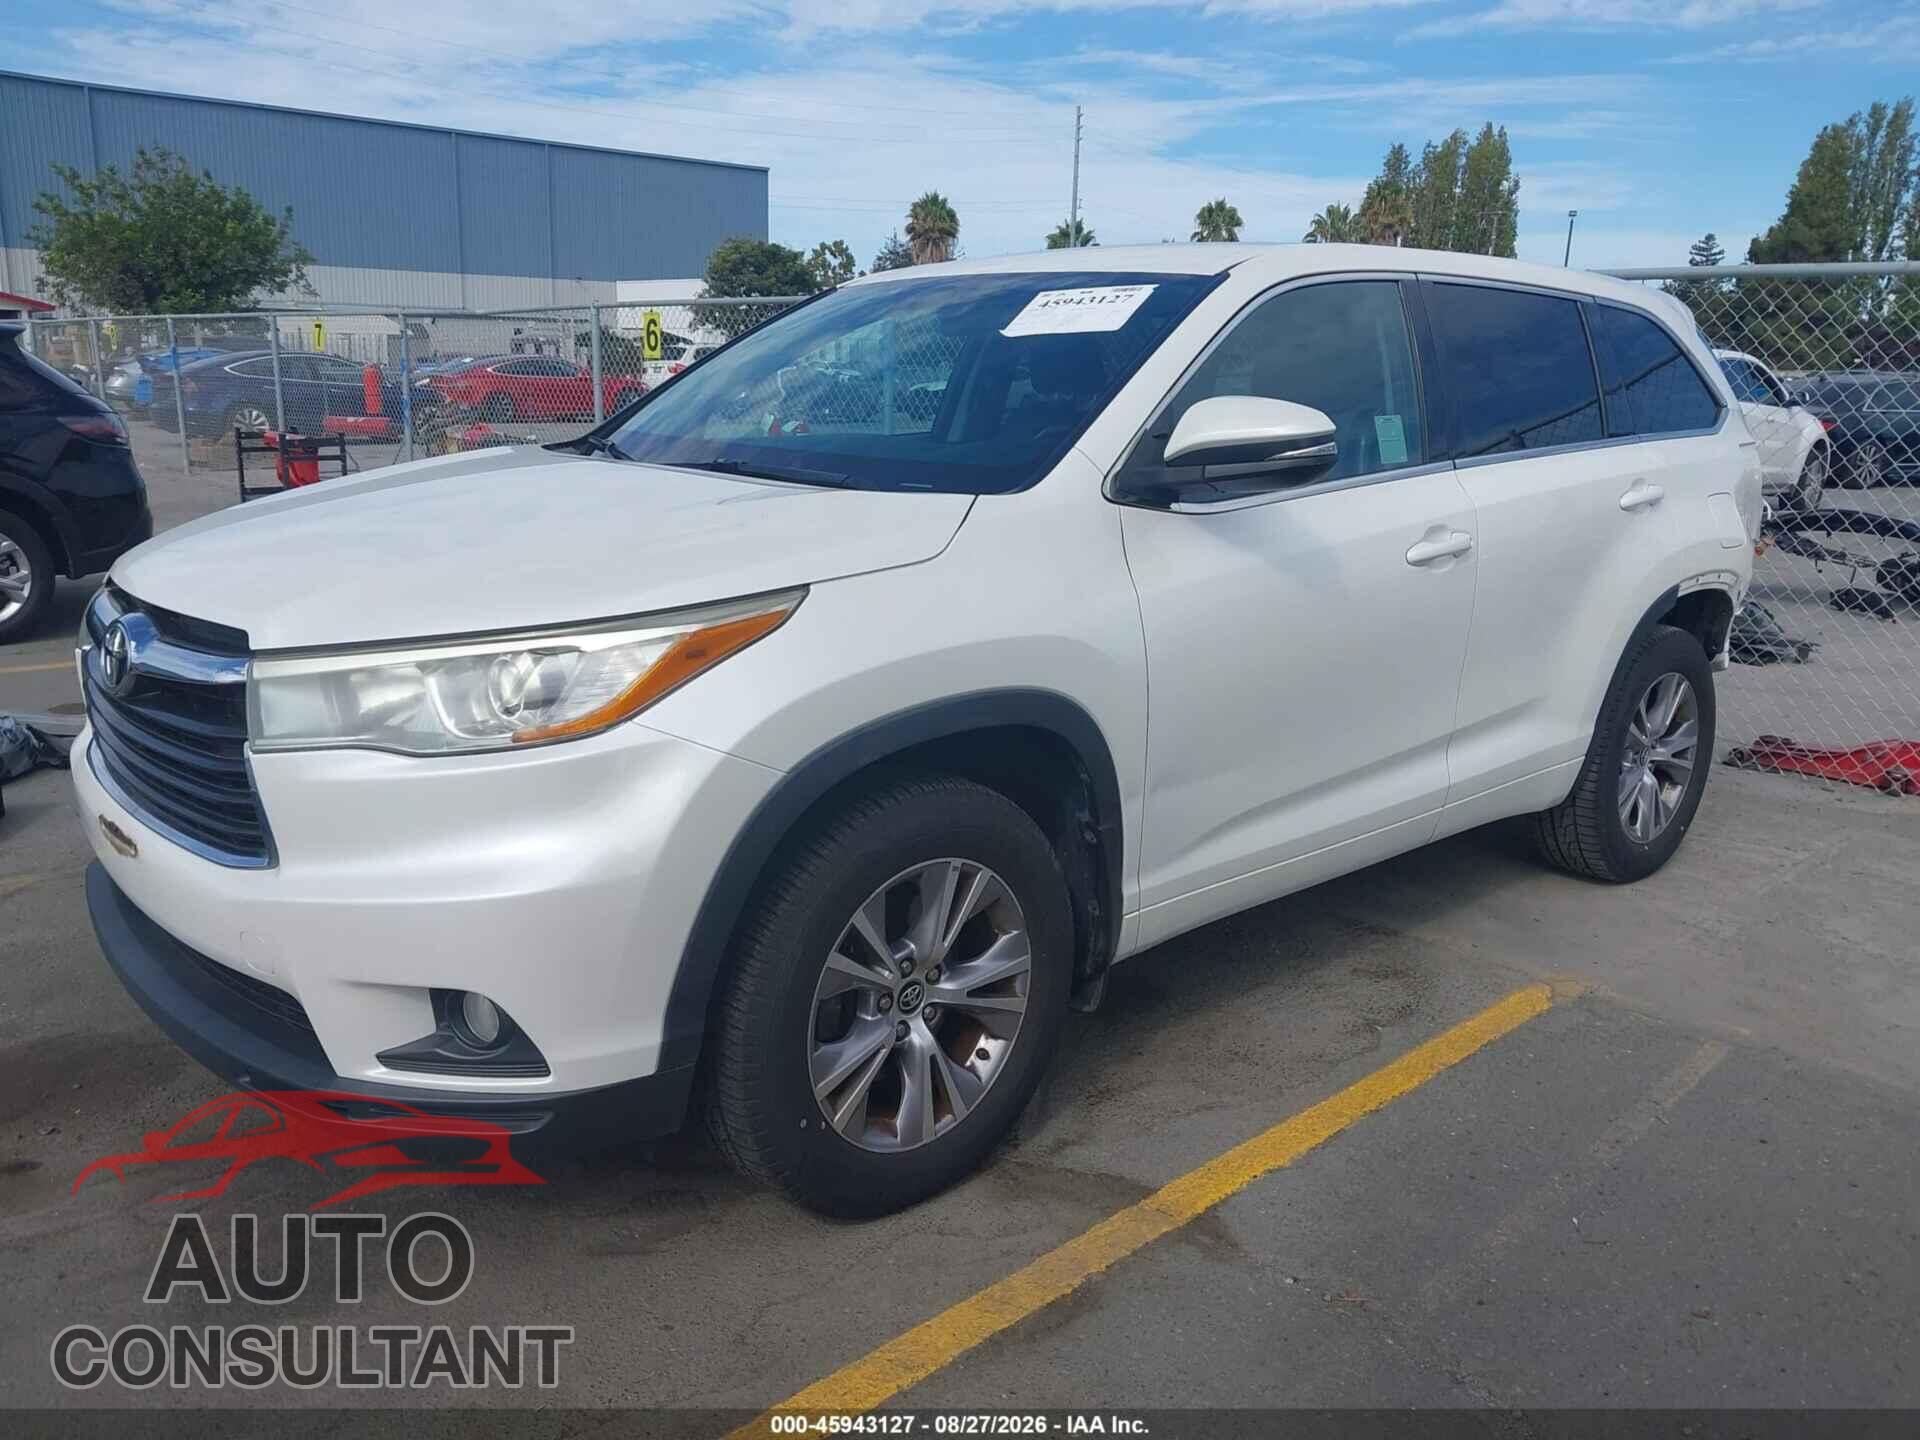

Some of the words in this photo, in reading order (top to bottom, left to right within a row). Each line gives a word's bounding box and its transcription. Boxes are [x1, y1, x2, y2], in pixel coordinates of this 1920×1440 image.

[1038, 294, 1135, 309] 45943127
[314, 323, 322, 348] 7
[646, 318, 659, 352] 6
